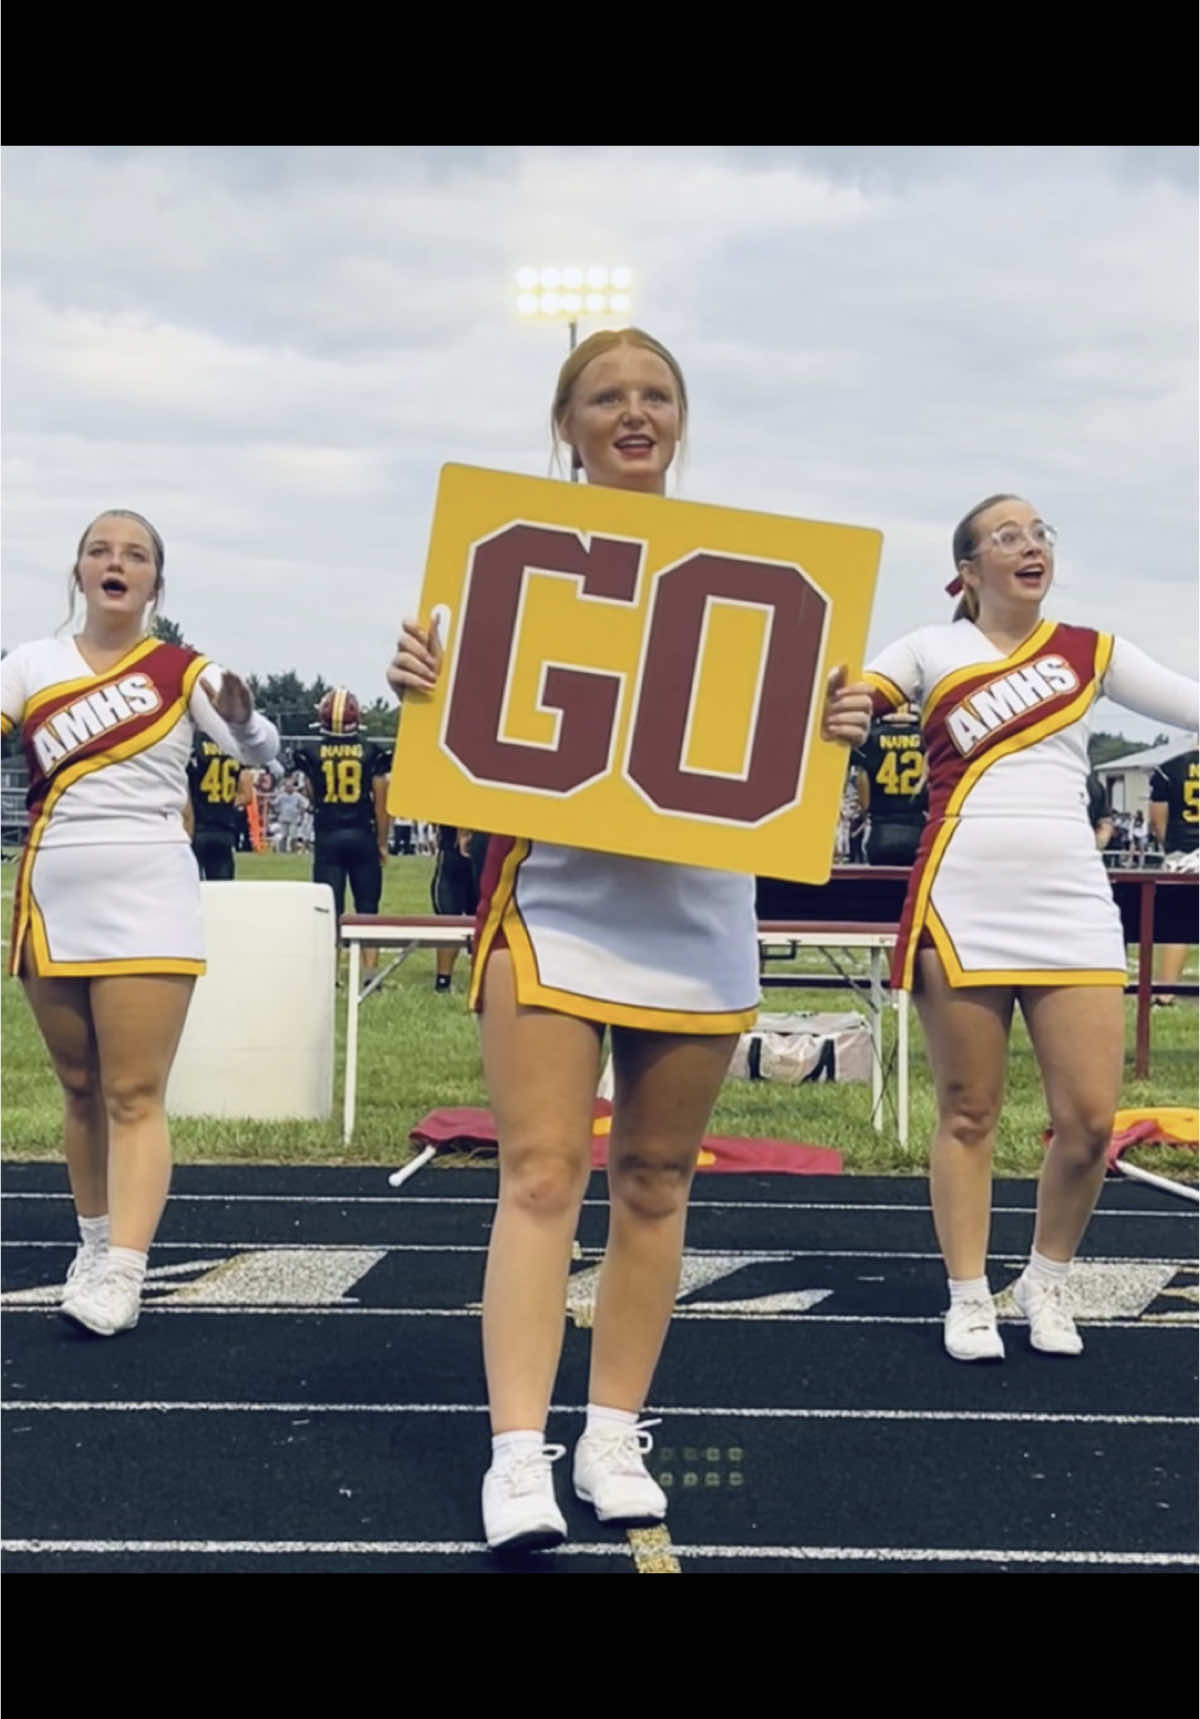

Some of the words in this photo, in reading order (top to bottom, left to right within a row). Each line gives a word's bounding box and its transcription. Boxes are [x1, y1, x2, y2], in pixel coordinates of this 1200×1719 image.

[438, 518, 833, 829] GO
[945, 654, 1079, 758] AMHS
[32, 673, 162, 777] AMHS
[201, 758, 239, 803] 46
[322, 760, 362, 803] 18
[876, 751, 923, 795] 42
